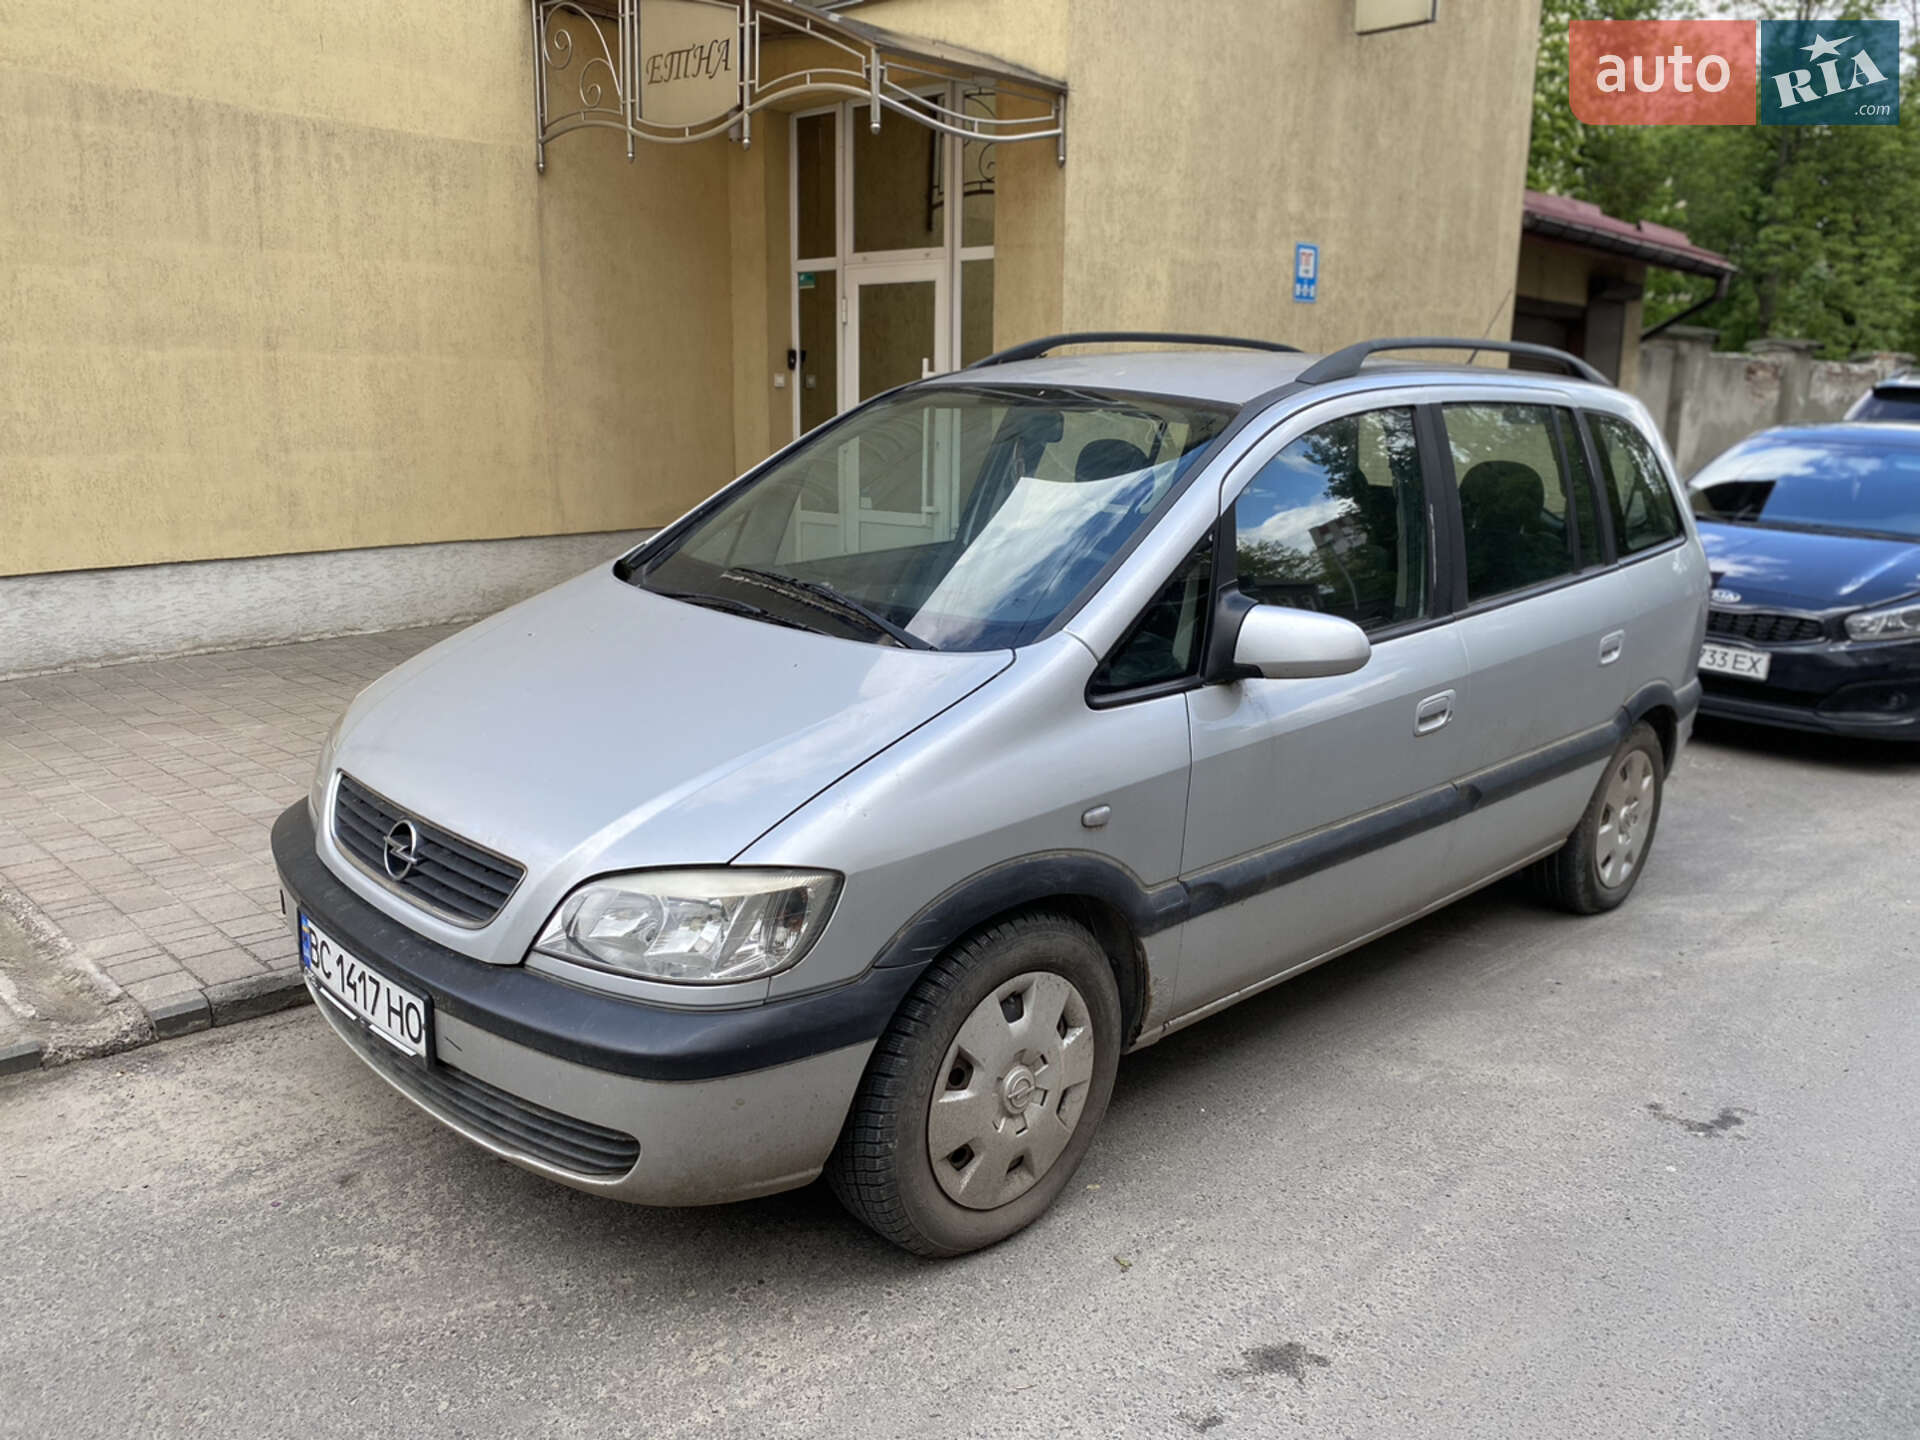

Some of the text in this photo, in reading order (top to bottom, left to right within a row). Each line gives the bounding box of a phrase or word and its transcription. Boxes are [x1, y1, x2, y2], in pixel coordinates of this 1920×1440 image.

[1702, 647, 1762, 674] 33 EX
[309, 926, 423, 1045] BC 1417 HO
